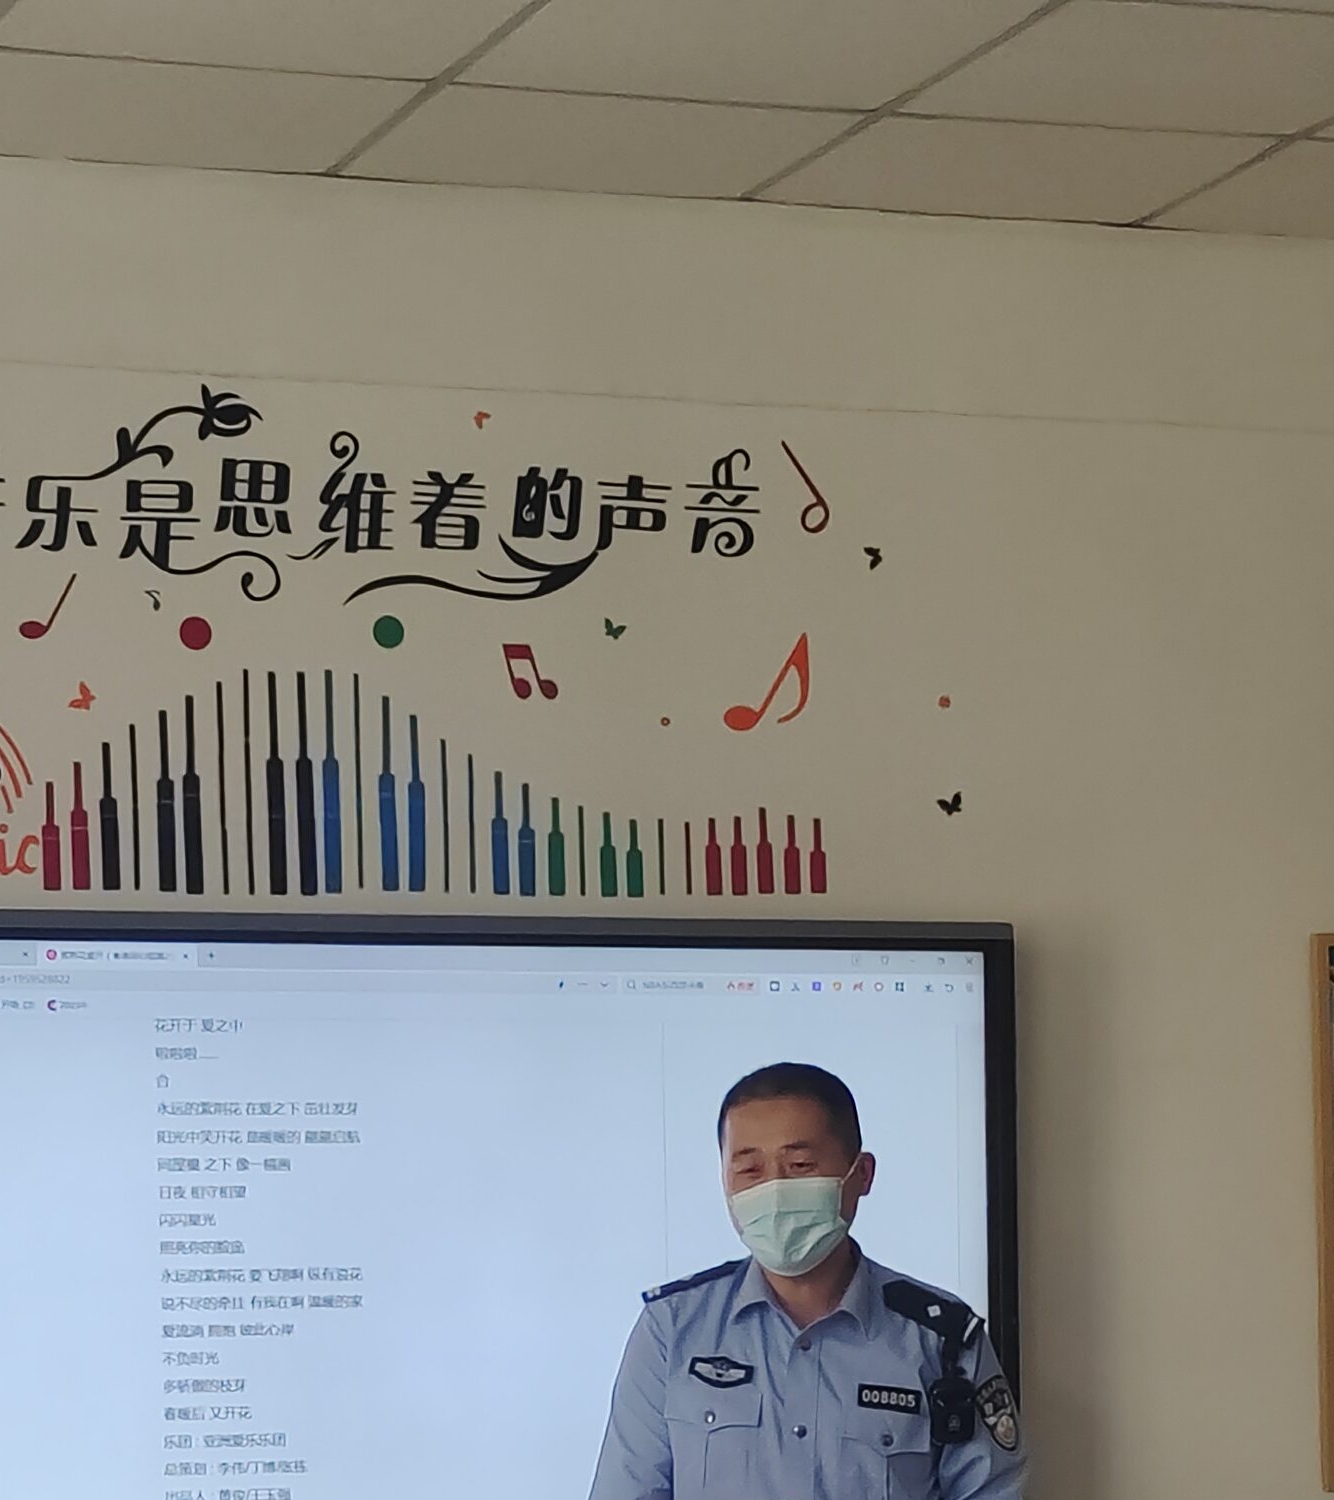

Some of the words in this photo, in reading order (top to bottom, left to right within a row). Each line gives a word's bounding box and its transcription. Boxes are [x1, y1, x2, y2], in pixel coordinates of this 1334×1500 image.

[159, 1185, 187, 1200] 日夜
[862, 1389, 916, 1408] 008805
[210, 1405, 253, 1420] 又开花
